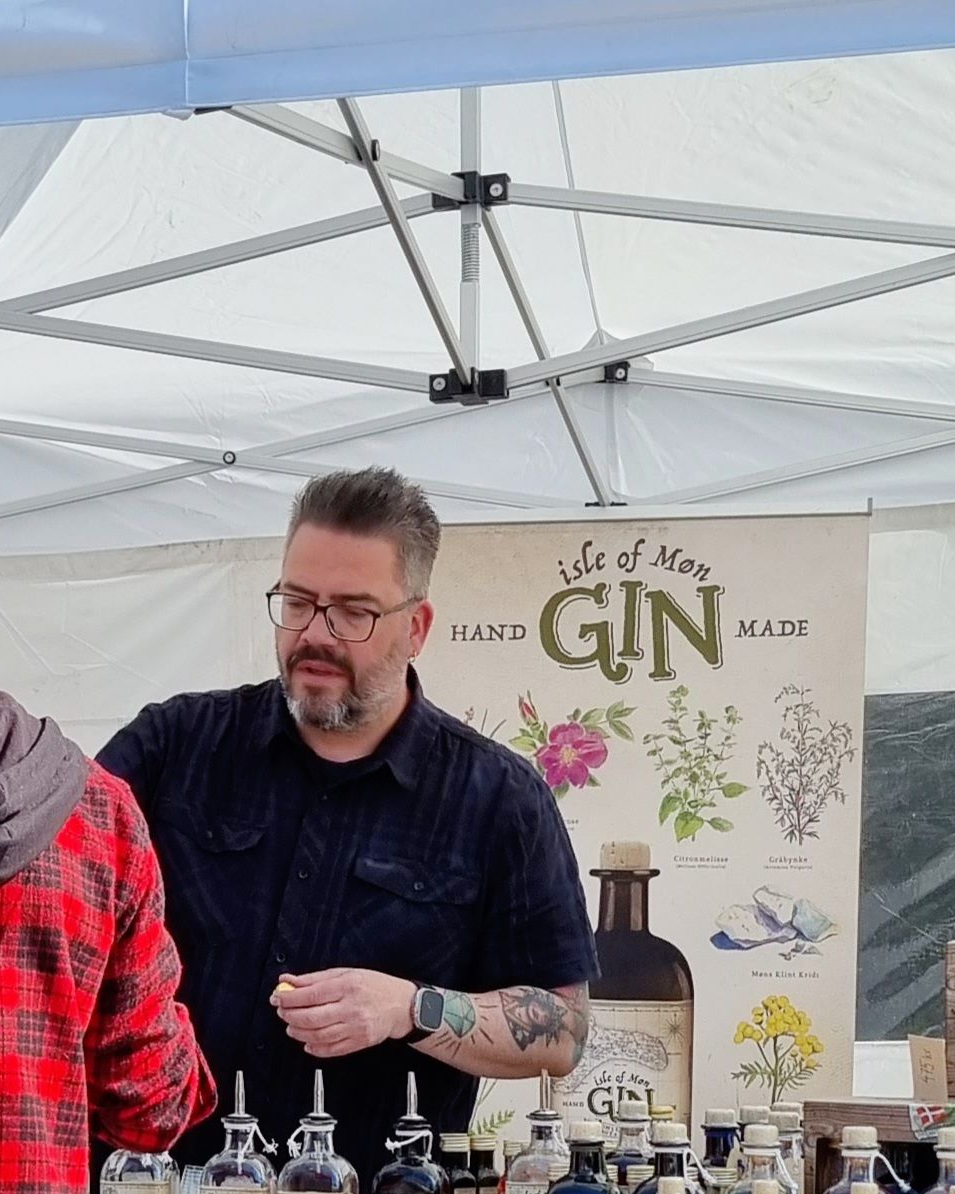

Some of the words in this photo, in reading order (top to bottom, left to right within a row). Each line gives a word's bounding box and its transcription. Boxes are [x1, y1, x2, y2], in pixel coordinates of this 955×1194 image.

[559, 540, 606, 585] isle
[617, 538, 645, 573] of
[649, 544, 712, 582] Møn
[450, 624, 527, 641] HAND
[538, 580, 725, 684] GIN
[735, 620, 809, 638] MADE
[594, 1070, 612, 1087] isle
[615, 1070, 626, 1084] of
